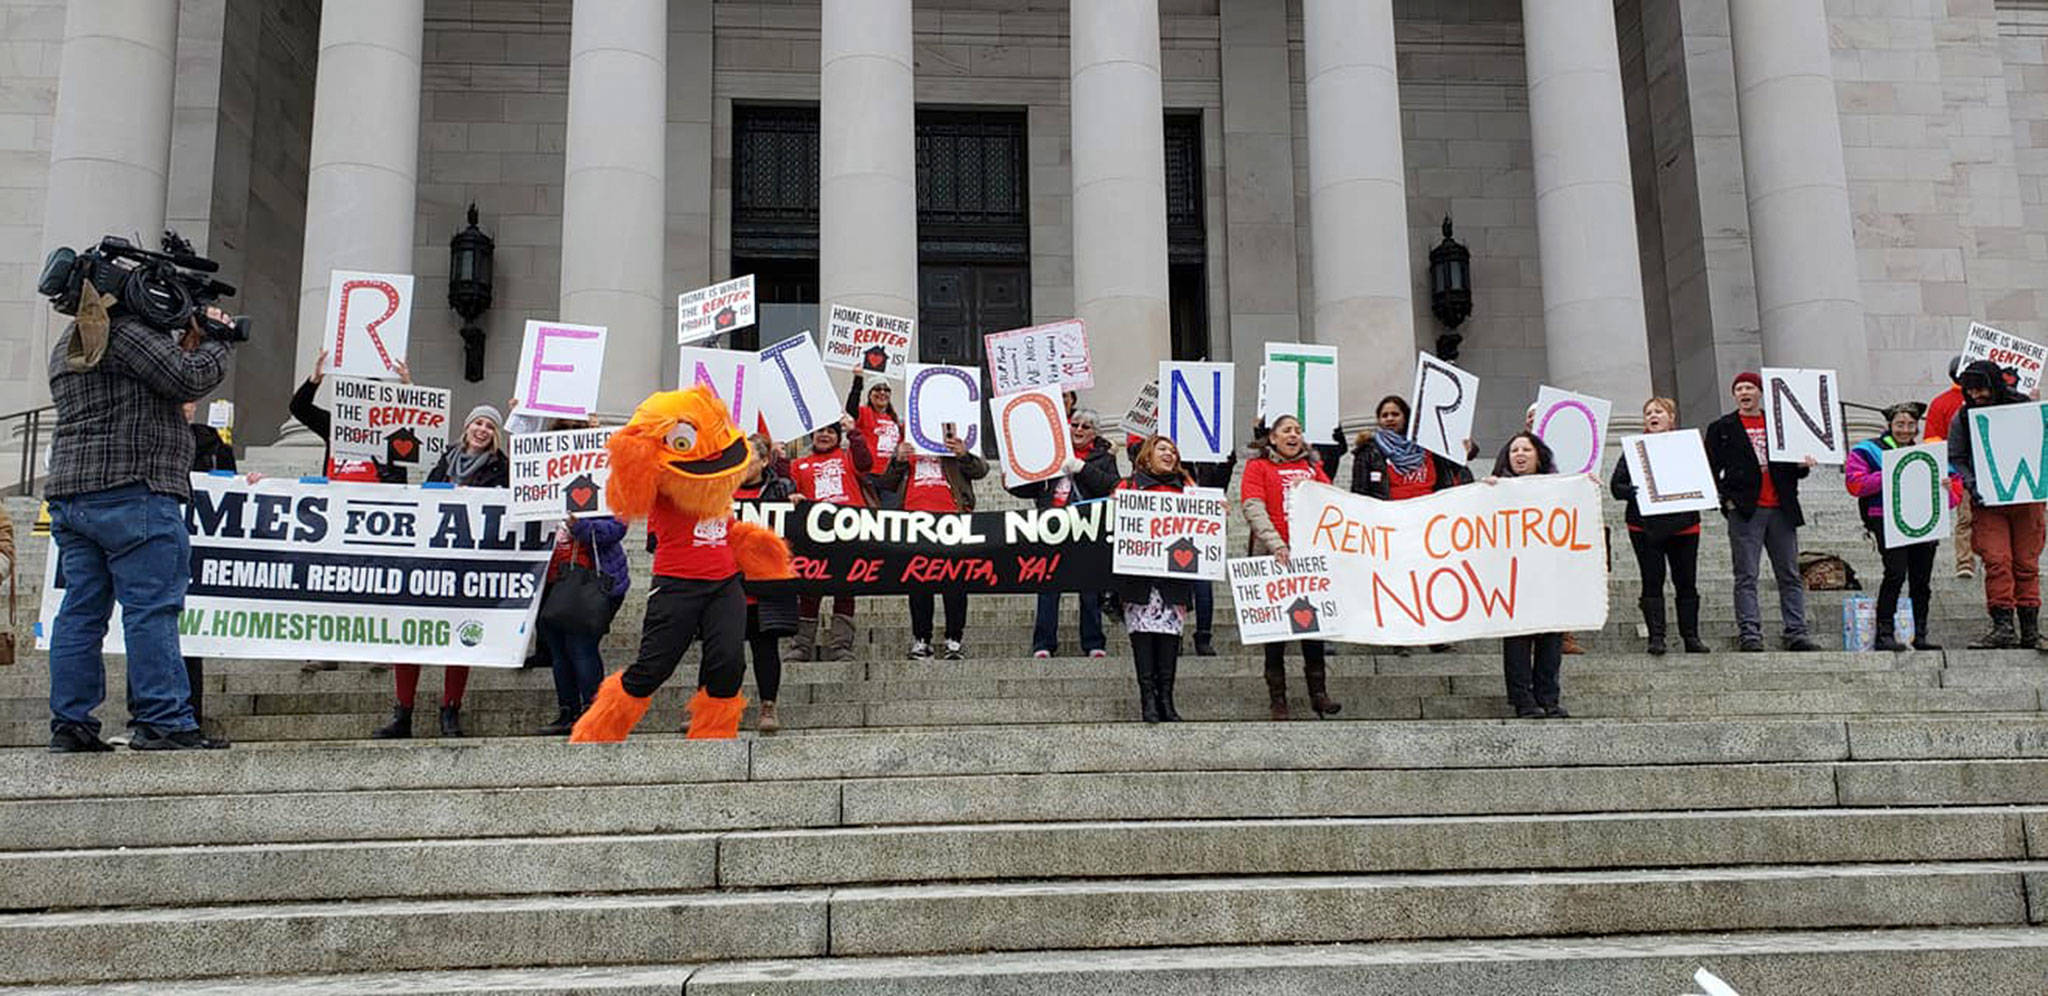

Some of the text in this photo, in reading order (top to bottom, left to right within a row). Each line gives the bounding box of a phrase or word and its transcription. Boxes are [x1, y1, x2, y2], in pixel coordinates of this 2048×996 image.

[702, 290, 751, 315] RENTER
[333, 281, 400, 370] R
[832, 324, 908, 348] THE RENTER
[833, 308, 911, 334] HOME IS WHERE
[828, 340, 862, 357] PROFIT
[1968, 340, 1987, 355] THE
[1988, 347, 2040, 372] RENTER
[1971, 326, 2045, 360] HOME IS WHERE
[525, 327, 600, 414] E
[760, 335, 813, 432] T
[336, 381, 446, 409] HOME IS WHERE
[1270, 353, 1334, 432] T
[1414, 359, 1463, 454] R
[336, 403, 445, 428] THE RENTER
[909, 367, 978, 454] C
[1170, 369, 1220, 454] N
[1772, 375, 1835, 451] N
[335, 426, 382, 445] PROFIT
[514, 436, 552, 455] HOME
[557, 435, 569, 451] IS
[1002, 395, 1067, 481] O
[1975, 404, 2048, 501] W
[514, 461, 540, 478] THE
[1635, 439, 1704, 503] L
[514, 483, 560, 502] PROFIT
[1119, 494, 1221, 516] HOME IS WHERE
[1892, 450, 1941, 539] O
[185, 490, 557, 551] MES FOR ALL
[806, 502, 986, 546] CONTROL
[1004, 498, 1114, 545] NOW!
[1120, 516, 1221, 539] THE RENTER
[1312, 505, 1592, 561] RENT CONTROL
[1118, 539, 1221, 562] PROFIT IS!
[1231, 556, 1328, 578] HOME IS WHERE
[202, 559, 299, 590] REMAIN.
[307, 564, 403, 595] REBUILD
[409, 569, 457, 597] OUR
[846, 558, 884, 582] DE
[901, 555, 998, 586] RENTA,
[1016, 553, 1061, 583] YA!
[1236, 576, 1331, 604] THE RENTER
[1372, 556, 1518, 628] NOW
[179, 608, 450, 646] W.HOMESFORALL.ORG
[1241, 600, 1338, 624] PROFIT IS!
